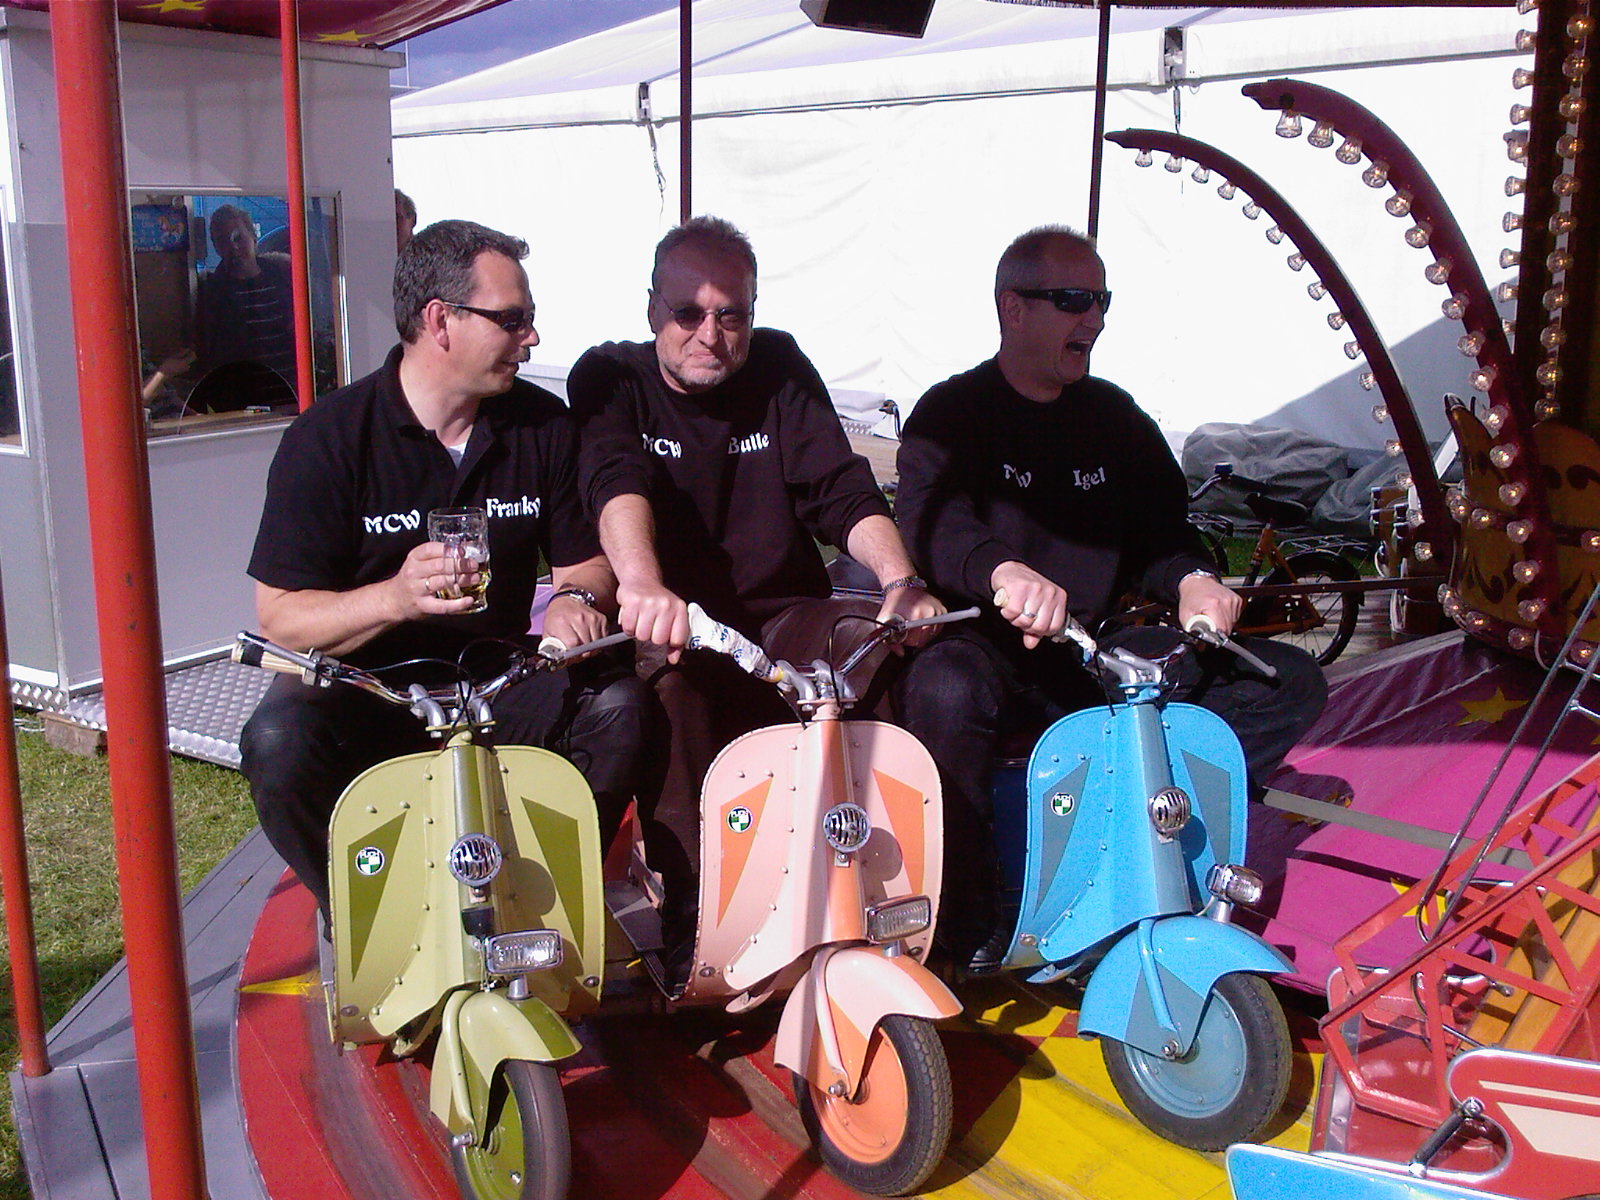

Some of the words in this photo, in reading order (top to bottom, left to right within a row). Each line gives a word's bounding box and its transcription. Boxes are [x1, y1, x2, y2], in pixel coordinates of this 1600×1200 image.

[642, 432, 682, 458] MCW
[728, 432, 770, 454] Bulle
[1072, 466, 1106, 491] Igel
[362, 509, 421, 534] MCW
[486, 495, 541, 519] Franky
